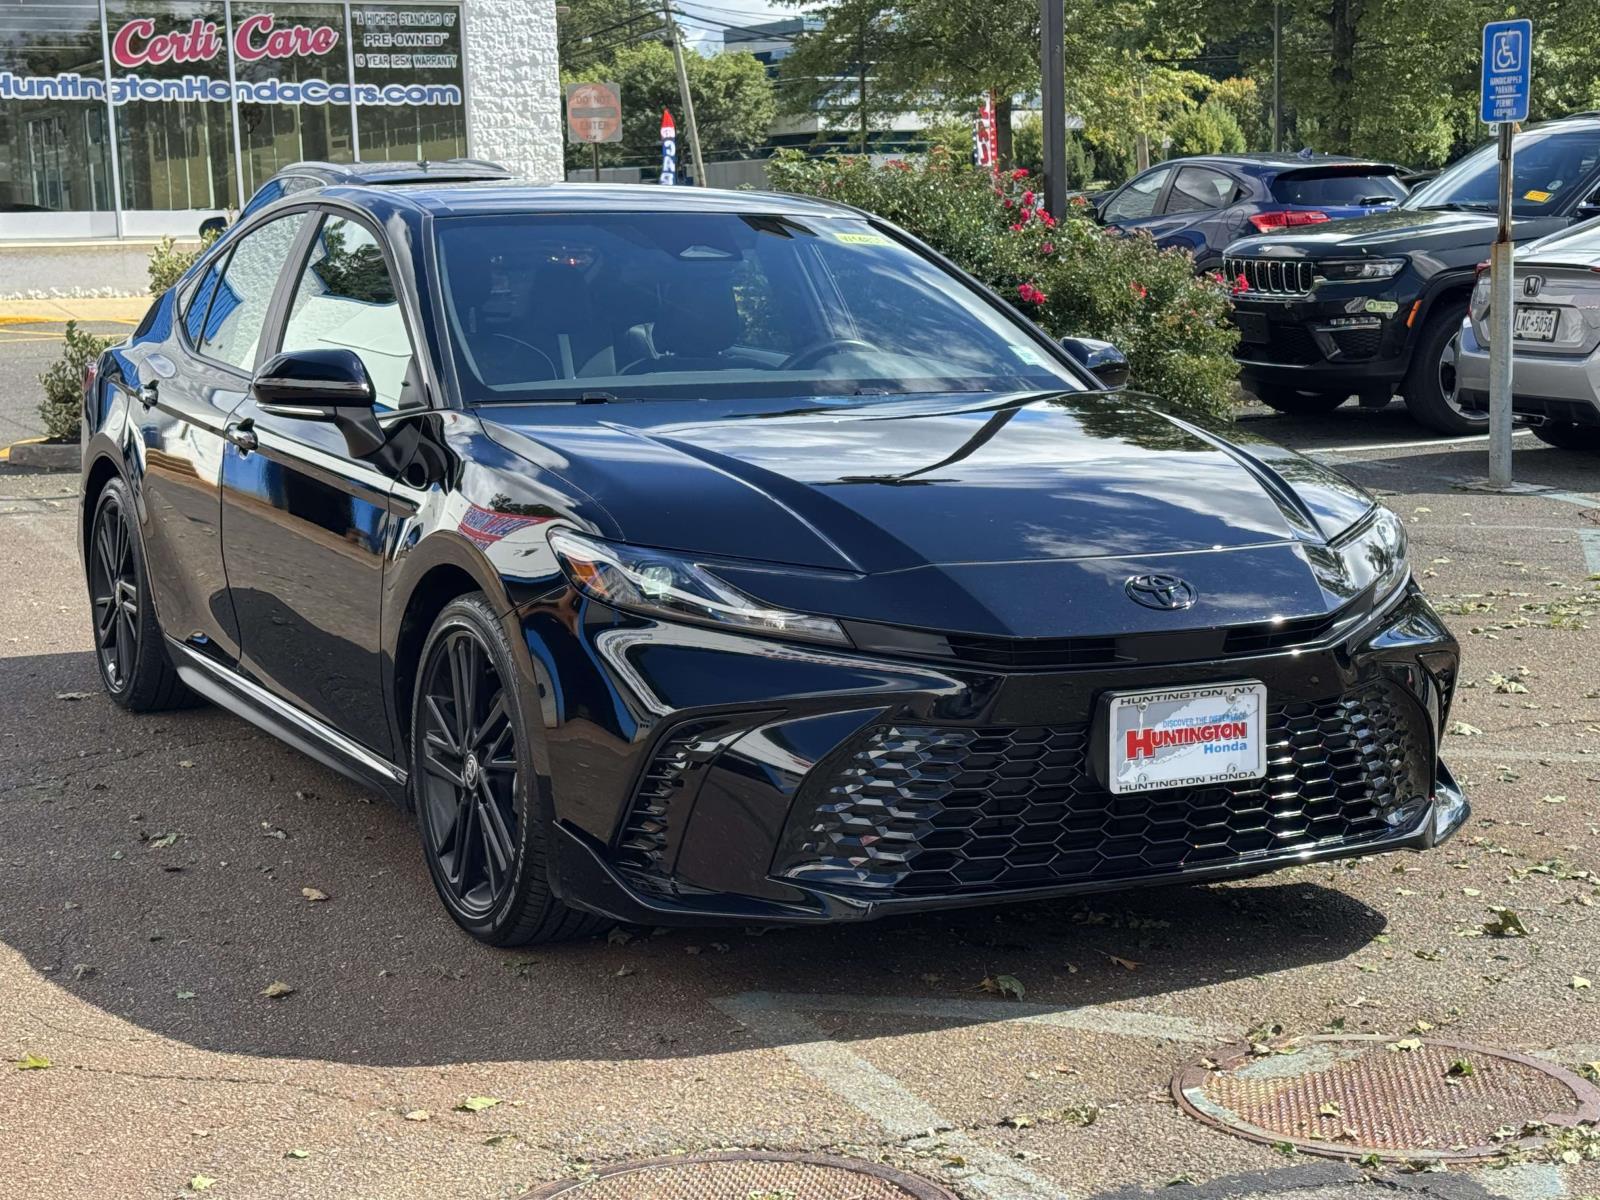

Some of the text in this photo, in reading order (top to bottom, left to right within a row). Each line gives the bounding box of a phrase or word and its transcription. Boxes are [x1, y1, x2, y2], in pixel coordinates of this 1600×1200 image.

[365, 12, 398, 26] HIGHER
[399, 12, 442, 26] STANDARD
[443, 13, 457, 26] OF
[113, 13, 339, 68] Certi Care
[354, 54, 458, 68] 10 YEAR 125K WARRANTY
[577, 97, 588, 105] DO
[1233, 686, 1256, 694] NY
[1162, 718, 1194, 728] DISCOVER
[1195, 717, 1208, 725] THE
[1204, 741, 1247, 754] Honda
[1119, 770, 1257, 793] HUNTINGTON HONDA
